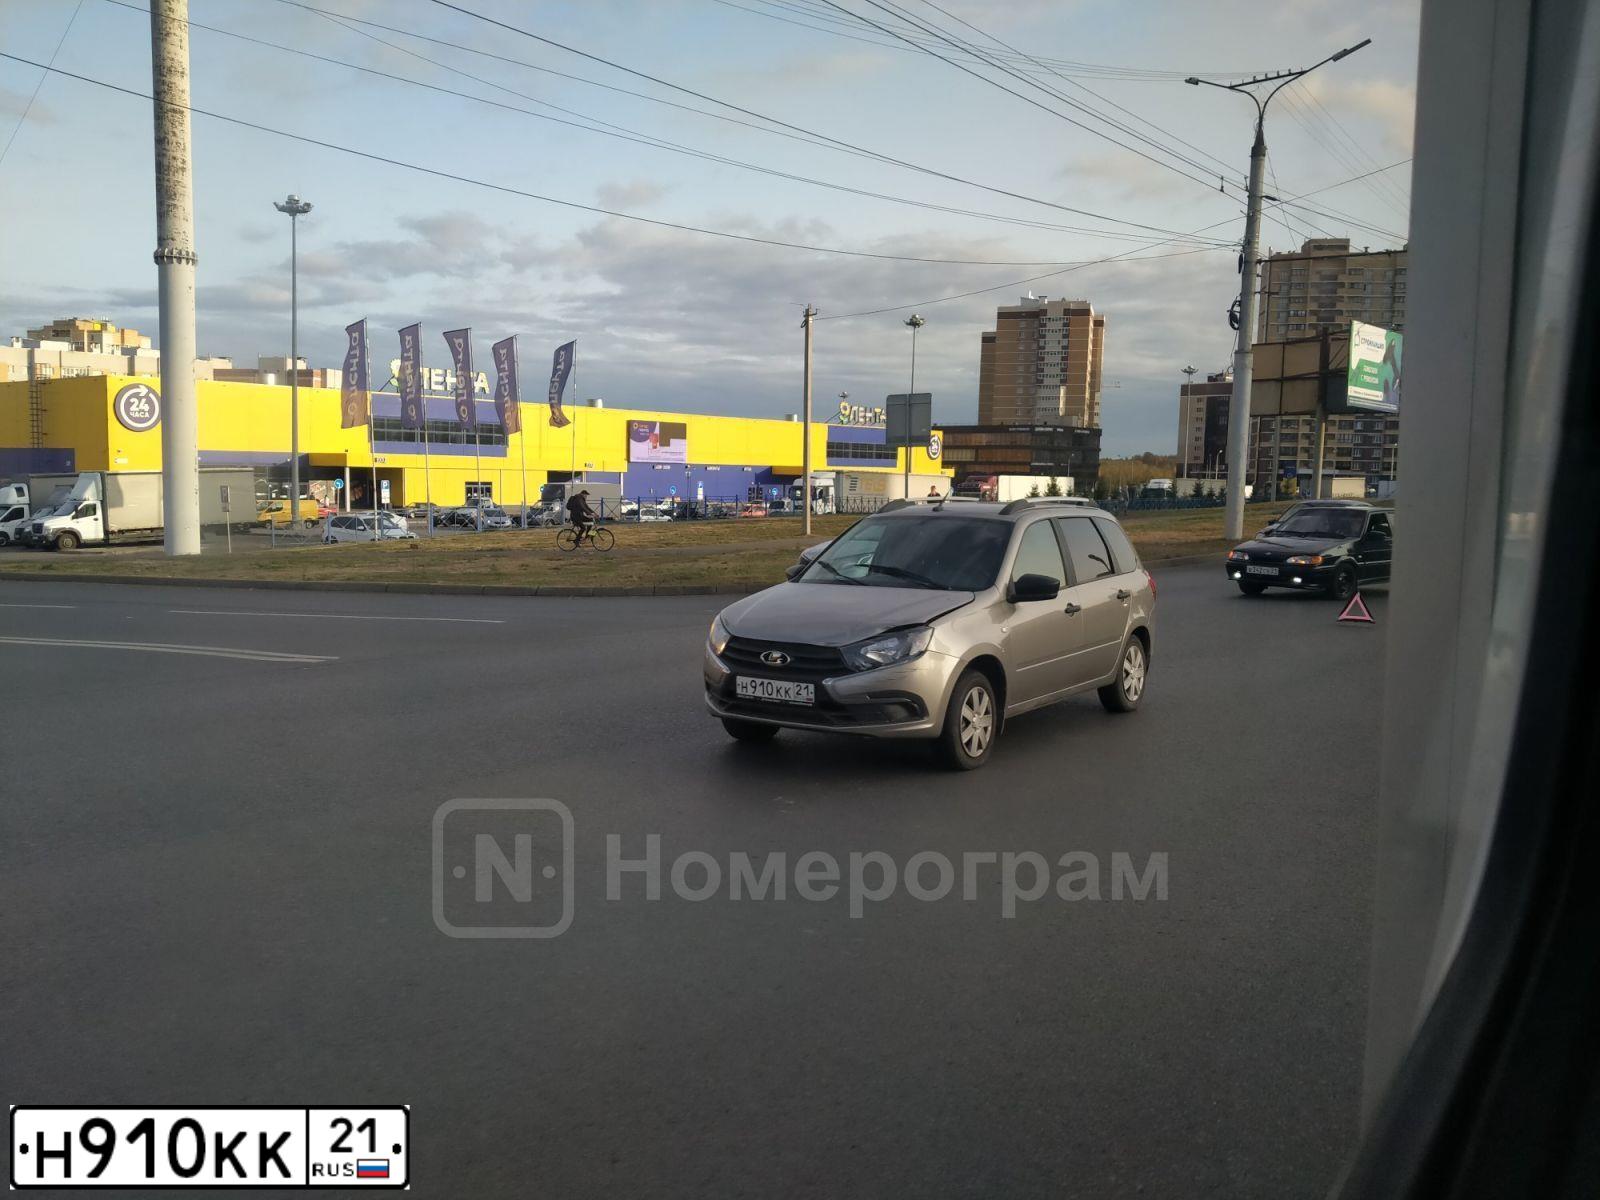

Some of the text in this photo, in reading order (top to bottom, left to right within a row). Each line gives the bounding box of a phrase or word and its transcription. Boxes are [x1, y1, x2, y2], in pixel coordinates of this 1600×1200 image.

[129, 398, 149, 412] 24
[740, 680, 791, 699] Н910КК
[795, 684, 809, 696] 21
